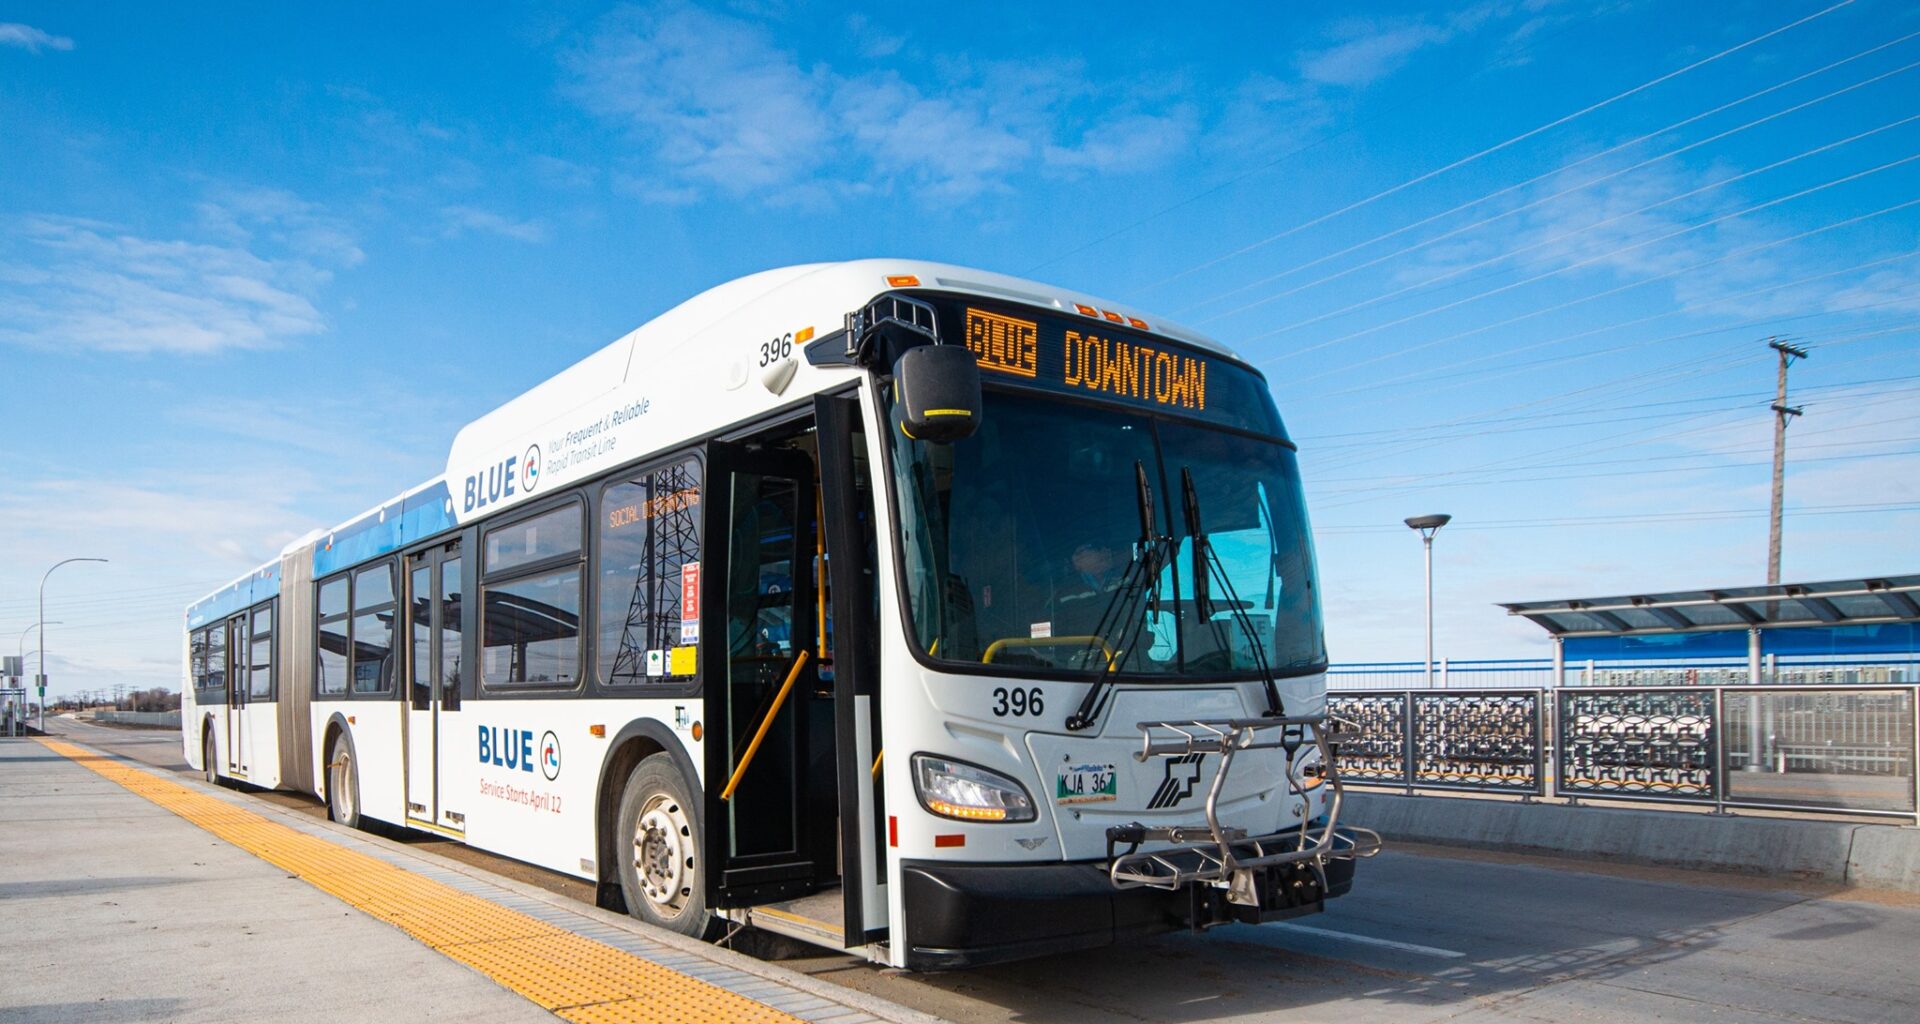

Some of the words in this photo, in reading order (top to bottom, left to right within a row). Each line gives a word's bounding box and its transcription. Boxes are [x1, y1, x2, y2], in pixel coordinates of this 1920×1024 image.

[760, 333, 791, 367] 396
[970, 314, 1034, 373] BLUE
[1064, 329, 1206, 410] DOWNTOWN
[565, 418, 603, 447] Frequent
[611, 397, 650, 428] Reliable
[546, 453, 569, 476] Rapid
[569, 440, 598, 465] Transit
[598, 436, 617, 455] Line
[464, 455, 517, 513] BLUE
[609, 504, 640, 528] SOCIAL
[993, 687, 1044, 717] 396
[478, 725, 534, 772] BLUE
[480, 778, 504, 799] Service
[506, 784, 528, 805] Starts
[530, 790, 549, 812] April
[551, 796, 562, 813] 12
[1061, 774, 1084, 794] KJA
[1091, 771, 1114, 793] 367
